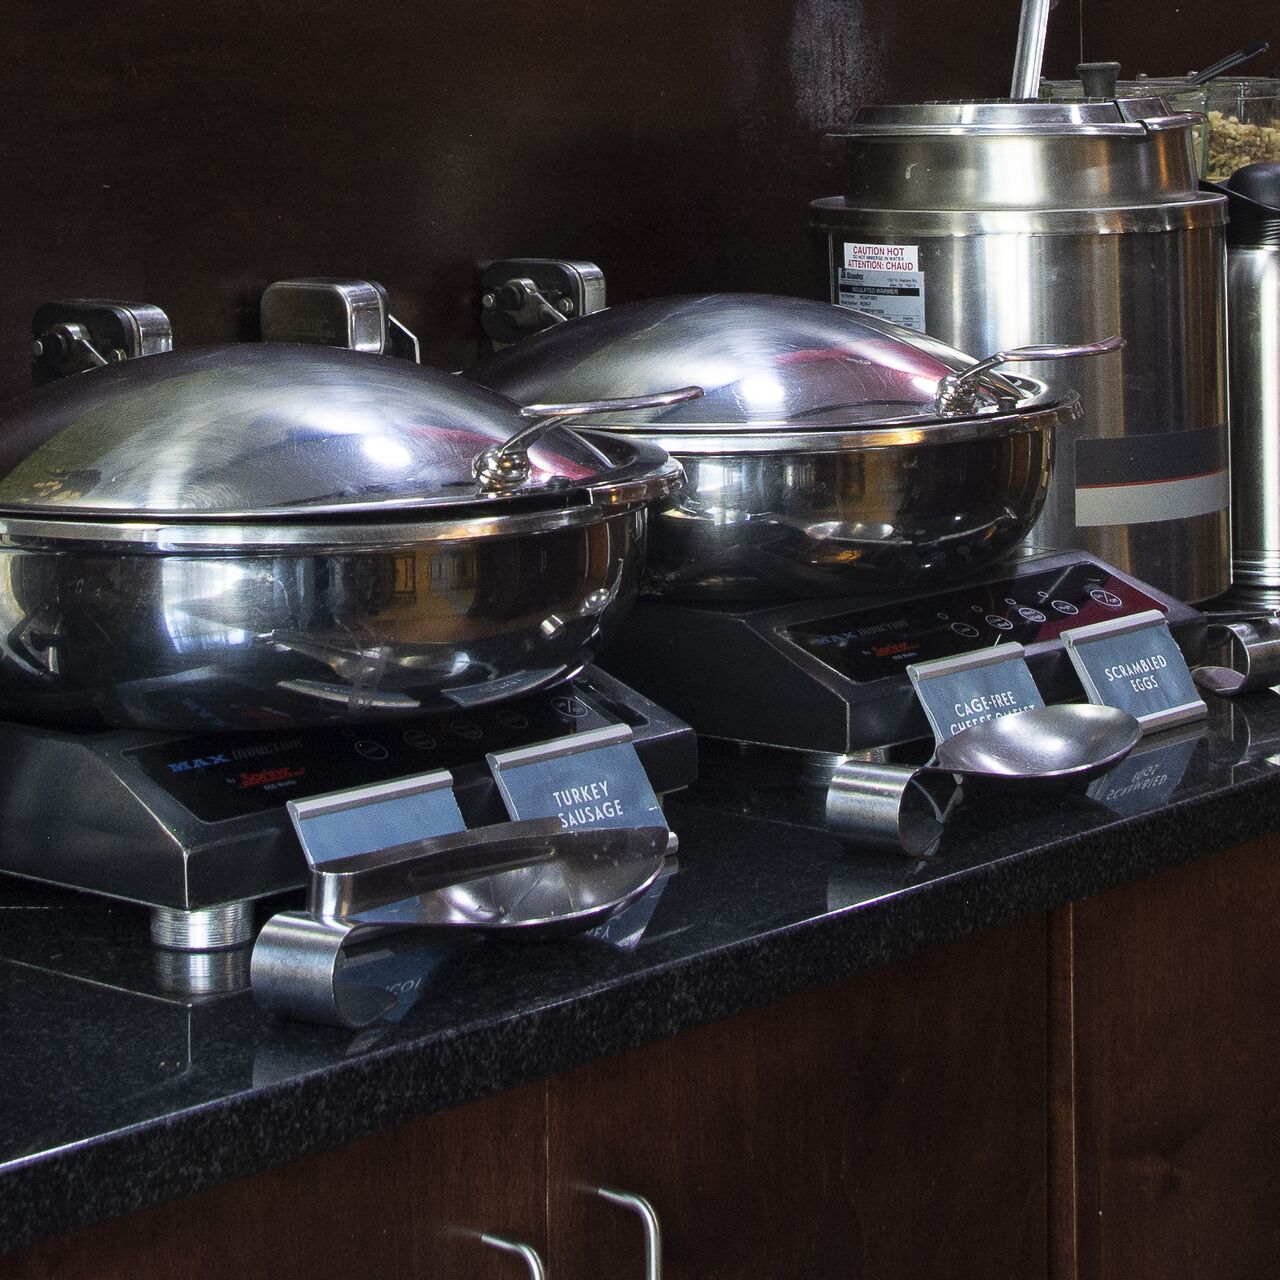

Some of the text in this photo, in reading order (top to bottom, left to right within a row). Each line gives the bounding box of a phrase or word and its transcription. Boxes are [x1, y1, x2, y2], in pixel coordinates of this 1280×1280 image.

[853, 246, 904, 256] CAUTION HOT
[848, 260, 913, 270] ATTENTION: CHAUD
[1104, 654, 1168, 682] SCRAMBLED
[1129, 674, 1159, 693] EGGS
[954, 690, 1017, 718] CAGE-FREE
[165, 753, 233, 775] MAX
[552, 780, 609, 808] TURKEY
[557, 799, 624, 828] SAUSAGE
